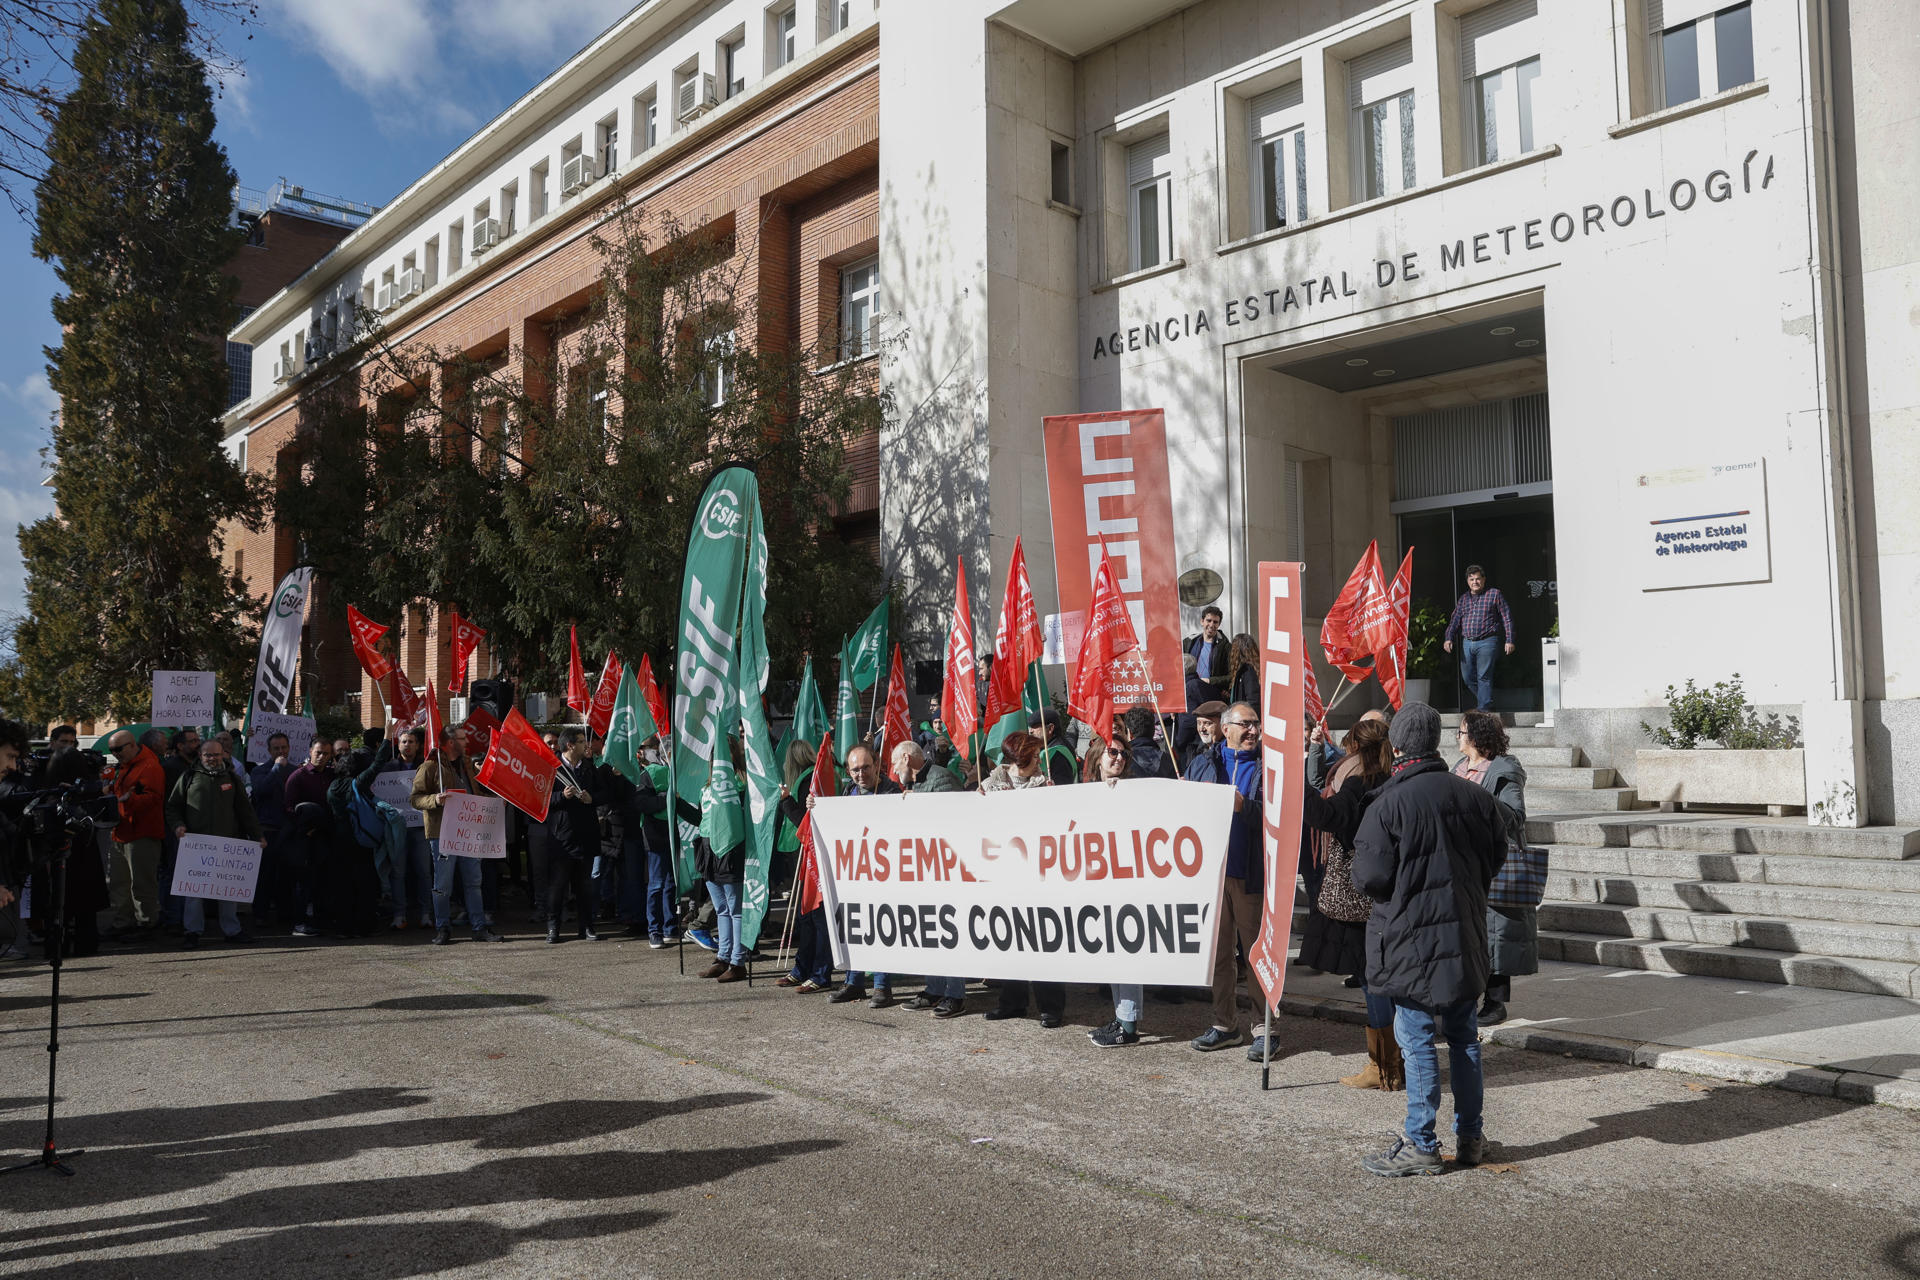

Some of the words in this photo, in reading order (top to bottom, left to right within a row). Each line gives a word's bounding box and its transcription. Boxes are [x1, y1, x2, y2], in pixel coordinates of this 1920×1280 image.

[1093, 309, 1210, 360] AGENCIA
[1225, 271, 1357, 326] ESTATAL
[1376, 252, 1420, 288] DE
[1440, 149, 1775, 272] METEOROLOGÍA
[710, 502, 742, 528] CSIF
[1655, 529, 1701, 544] Agencia
[1705, 523, 1748, 538] Estatal
[1656, 545, 1670, 557] de
[281, 593, 304, 610] CSIF
[457, 625, 484, 646] GT
[674, 576, 735, 762] CSIF
[170, 676, 200, 687] AEMET
[257, 642, 289, 714] SIF
[1153, 681, 1163, 691] la
[166, 694, 178, 704] NO
[181, 694, 204, 704] PAGA
[156, 709, 182, 718] HORAS
[185, 708, 213, 718] EXTRA
[258, 713, 272, 723] SIN
[276, 716, 302, 727] CURSOS
[497, 747, 534, 781] UGT
[712, 769, 742, 805] CSIF
[463, 801, 477, 812] NO
[456, 828, 471, 839] NO
[184, 842, 217, 851] NUESTRA
[223, 843, 256, 856] BUENA
[835, 826, 890, 882] MÁS
[1039, 819, 1204, 881] PÚBLICO
[201, 855, 254, 871] VOLUNTAD
[188, 869, 212, 878] CUBRE
[216, 872, 246, 881] VUESTRA
[178, 880, 252, 898] INUTILIDAD
[968, 903, 1209, 954] CONDICIONE
